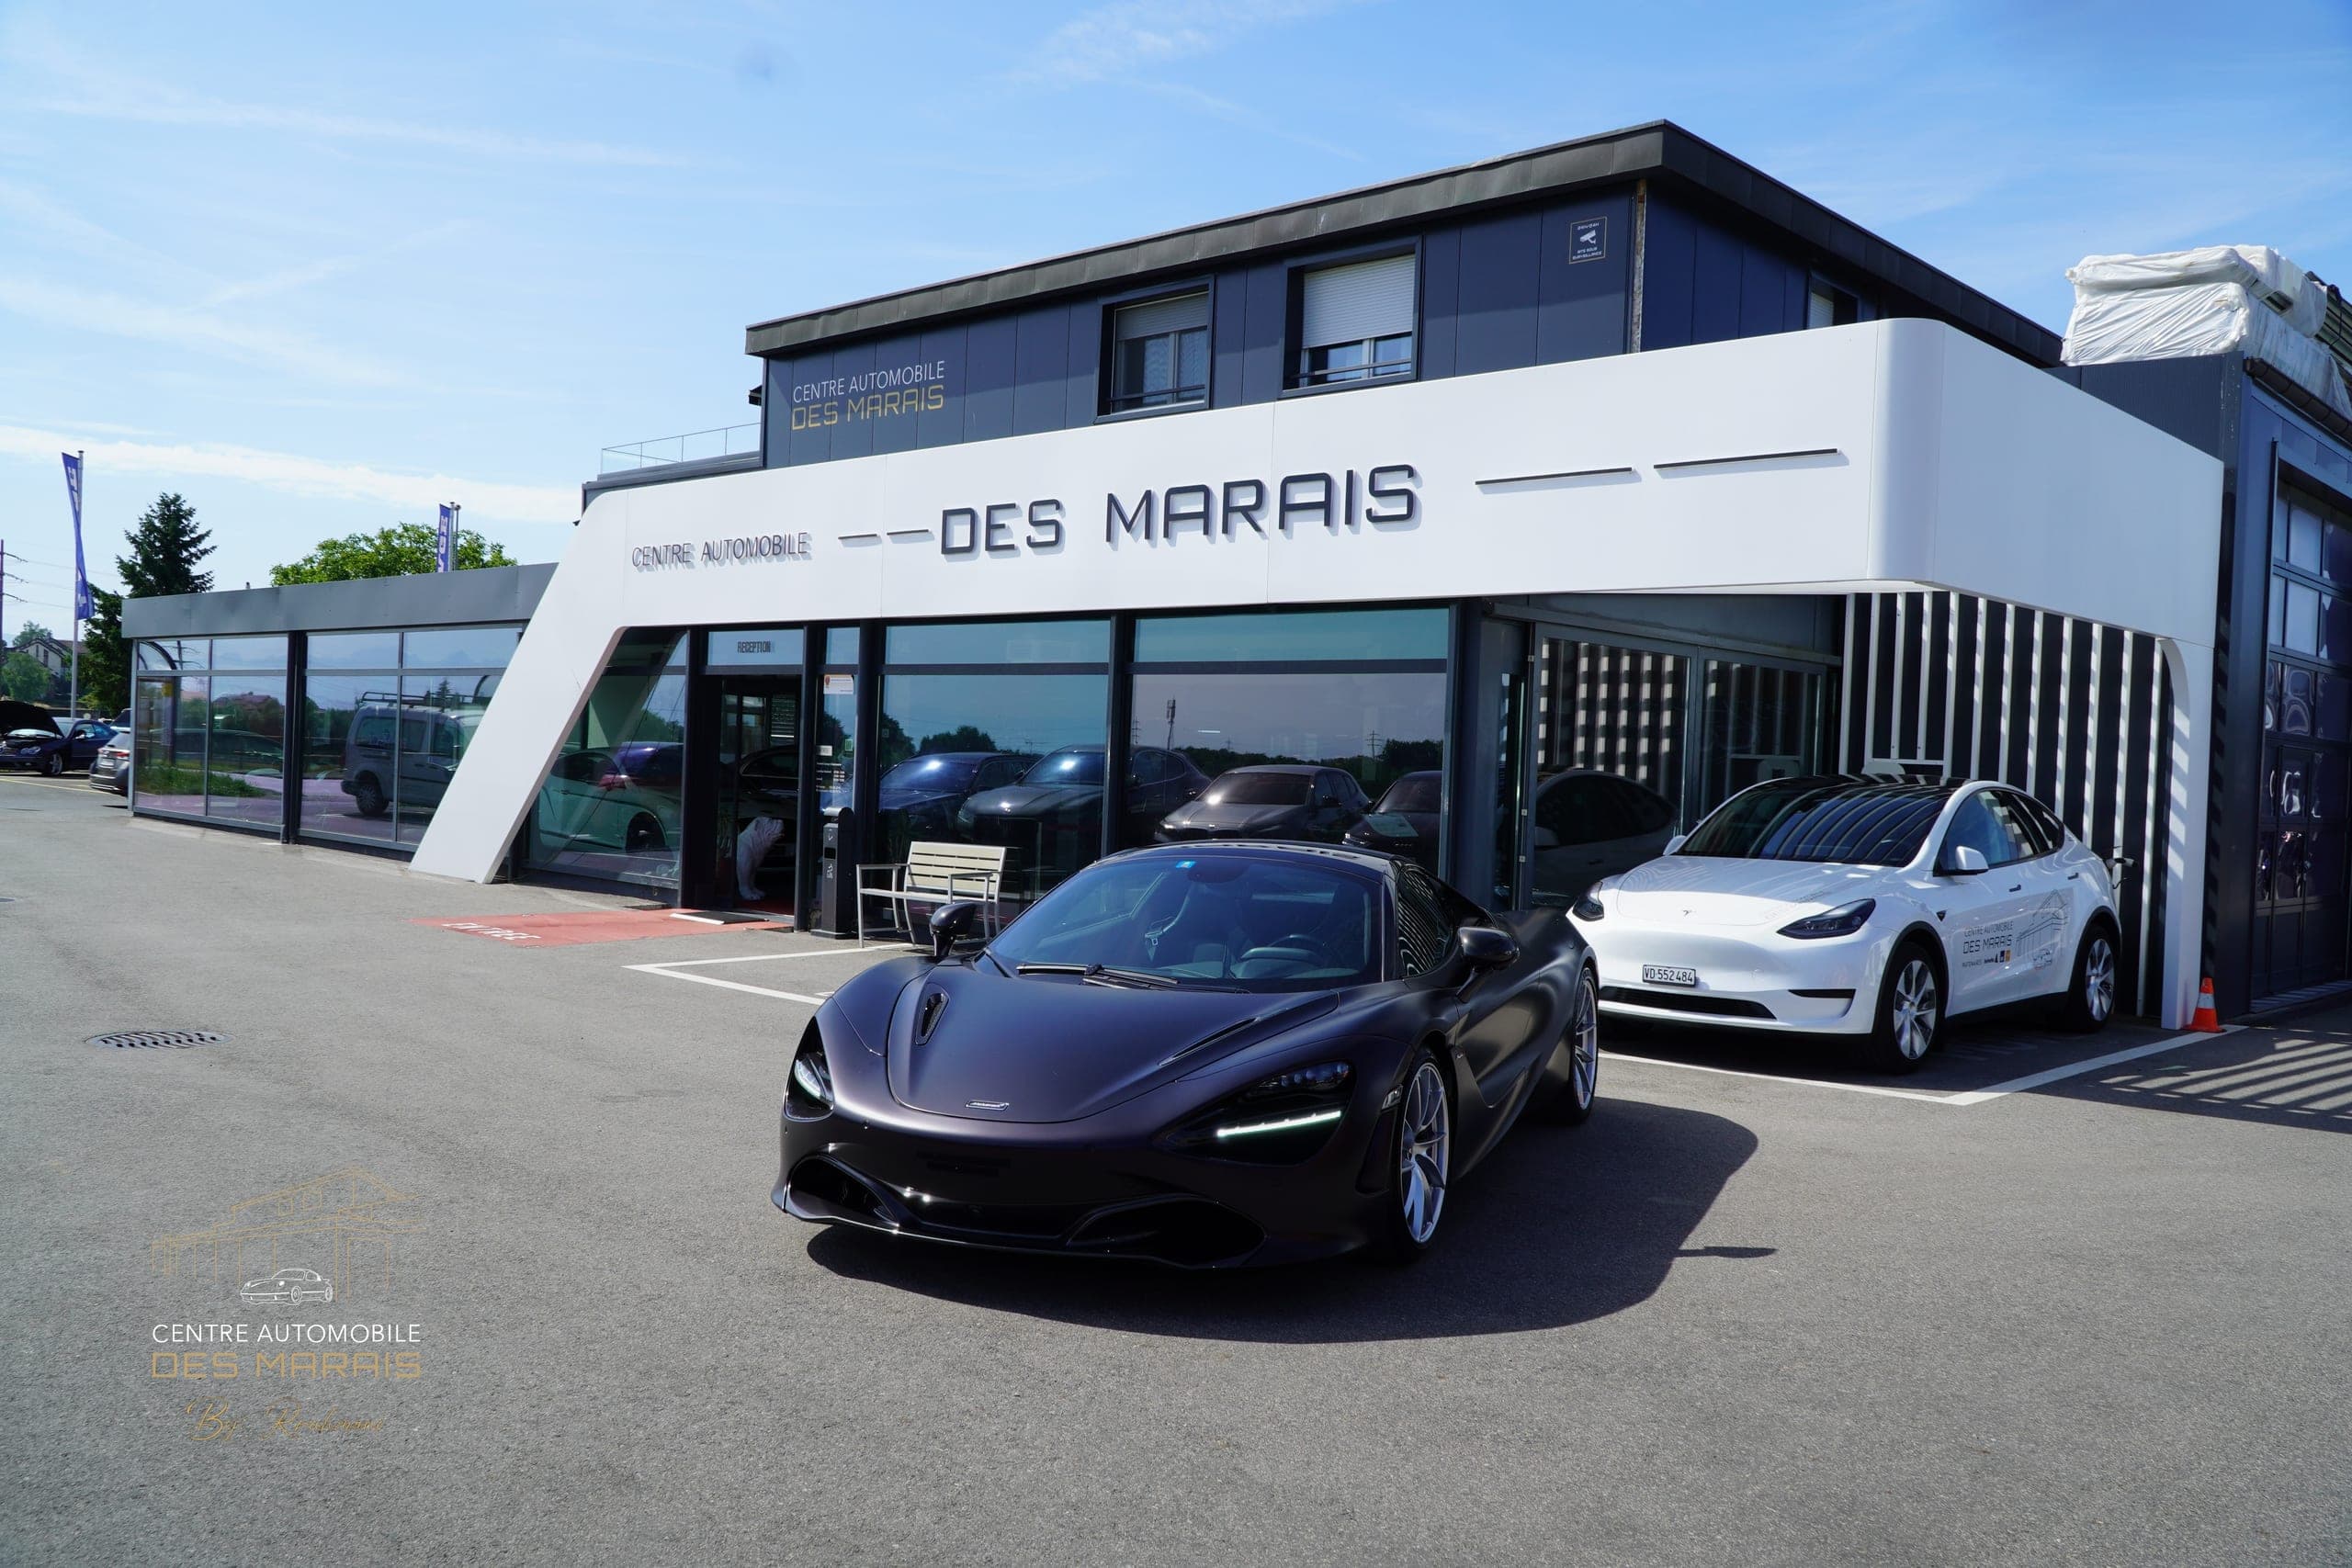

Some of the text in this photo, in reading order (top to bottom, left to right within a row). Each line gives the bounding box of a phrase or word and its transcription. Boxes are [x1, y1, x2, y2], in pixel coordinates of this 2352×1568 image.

[793, 360, 945, 403] CENTRE AUTOMOBILE
[791, 384, 944, 431] DES MARAIS
[632, 464, 1415, 568] CENTRE AUTOMOBILE DES MARAIS
[1962, 934, 2012, 953] DES MARAIS
